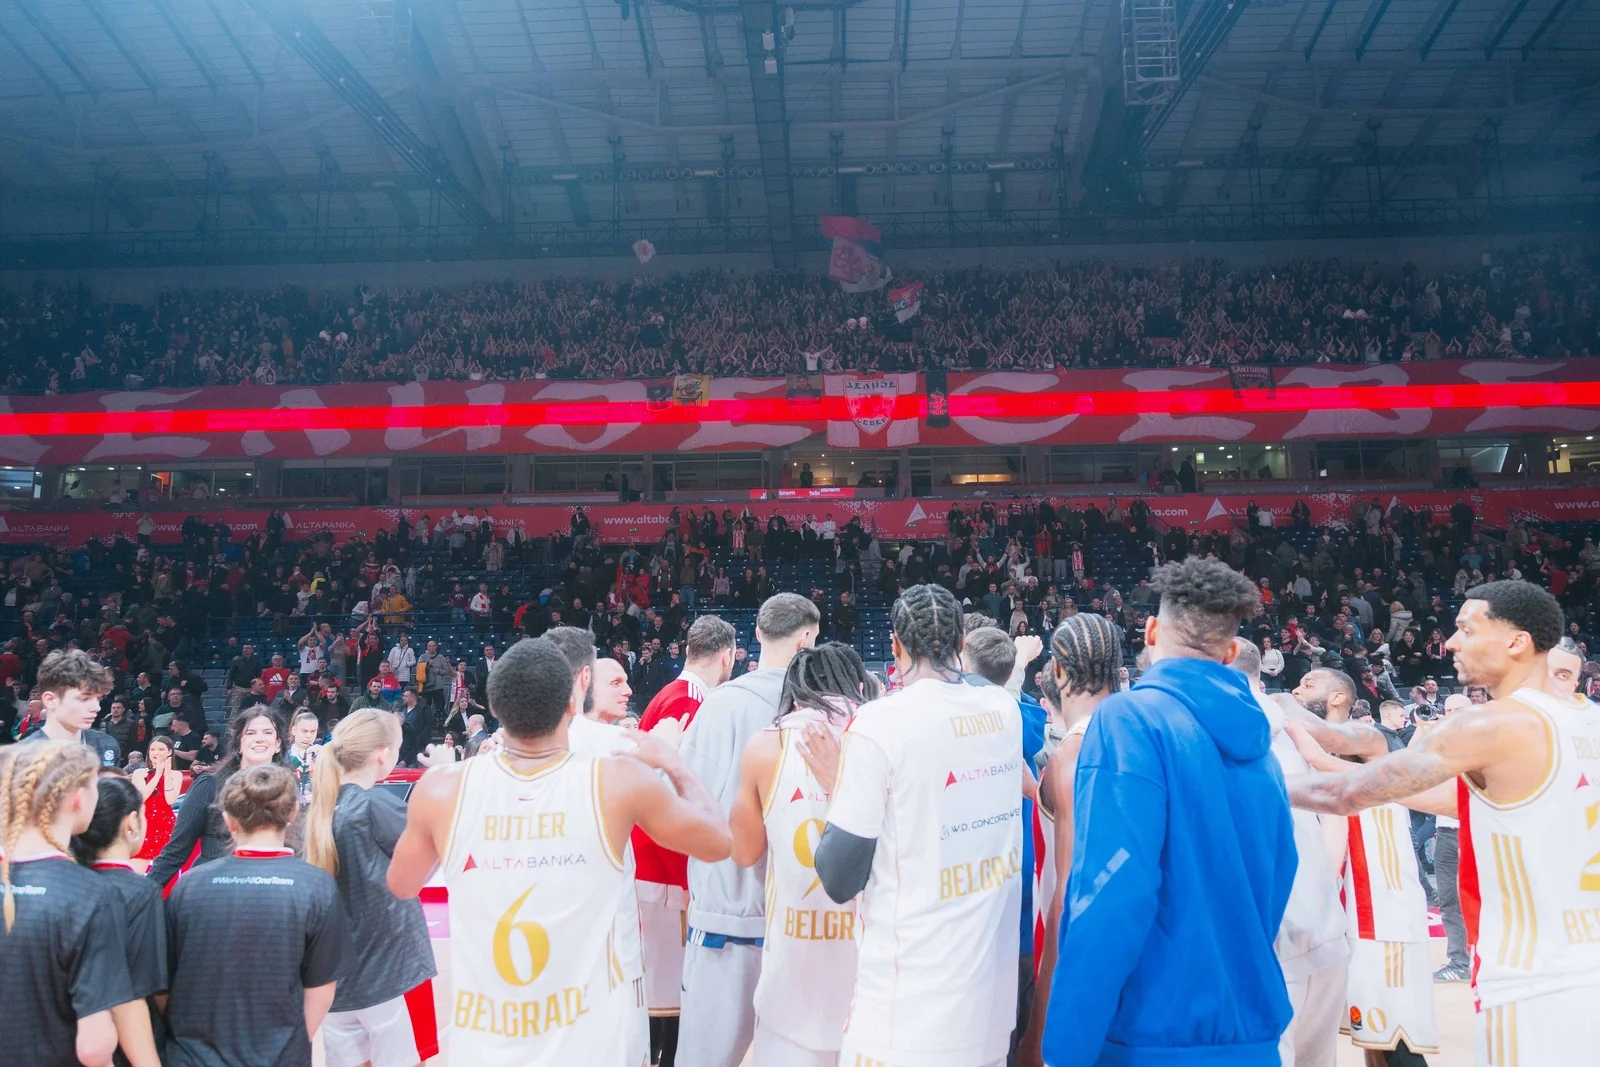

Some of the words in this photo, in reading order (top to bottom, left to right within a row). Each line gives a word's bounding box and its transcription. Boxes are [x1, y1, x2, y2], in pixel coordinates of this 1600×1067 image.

[295, 521, 356, 529] ALTABANKA
[949, 710, 1005, 738] IZUNDU
[483, 812, 566, 841] BUTLER
[971, 812, 1010, 830] CONCORD
[480, 852, 587, 870] ALTABANKA
[793, 817, 828, 901] 9
[492, 881, 551, 988] 6
